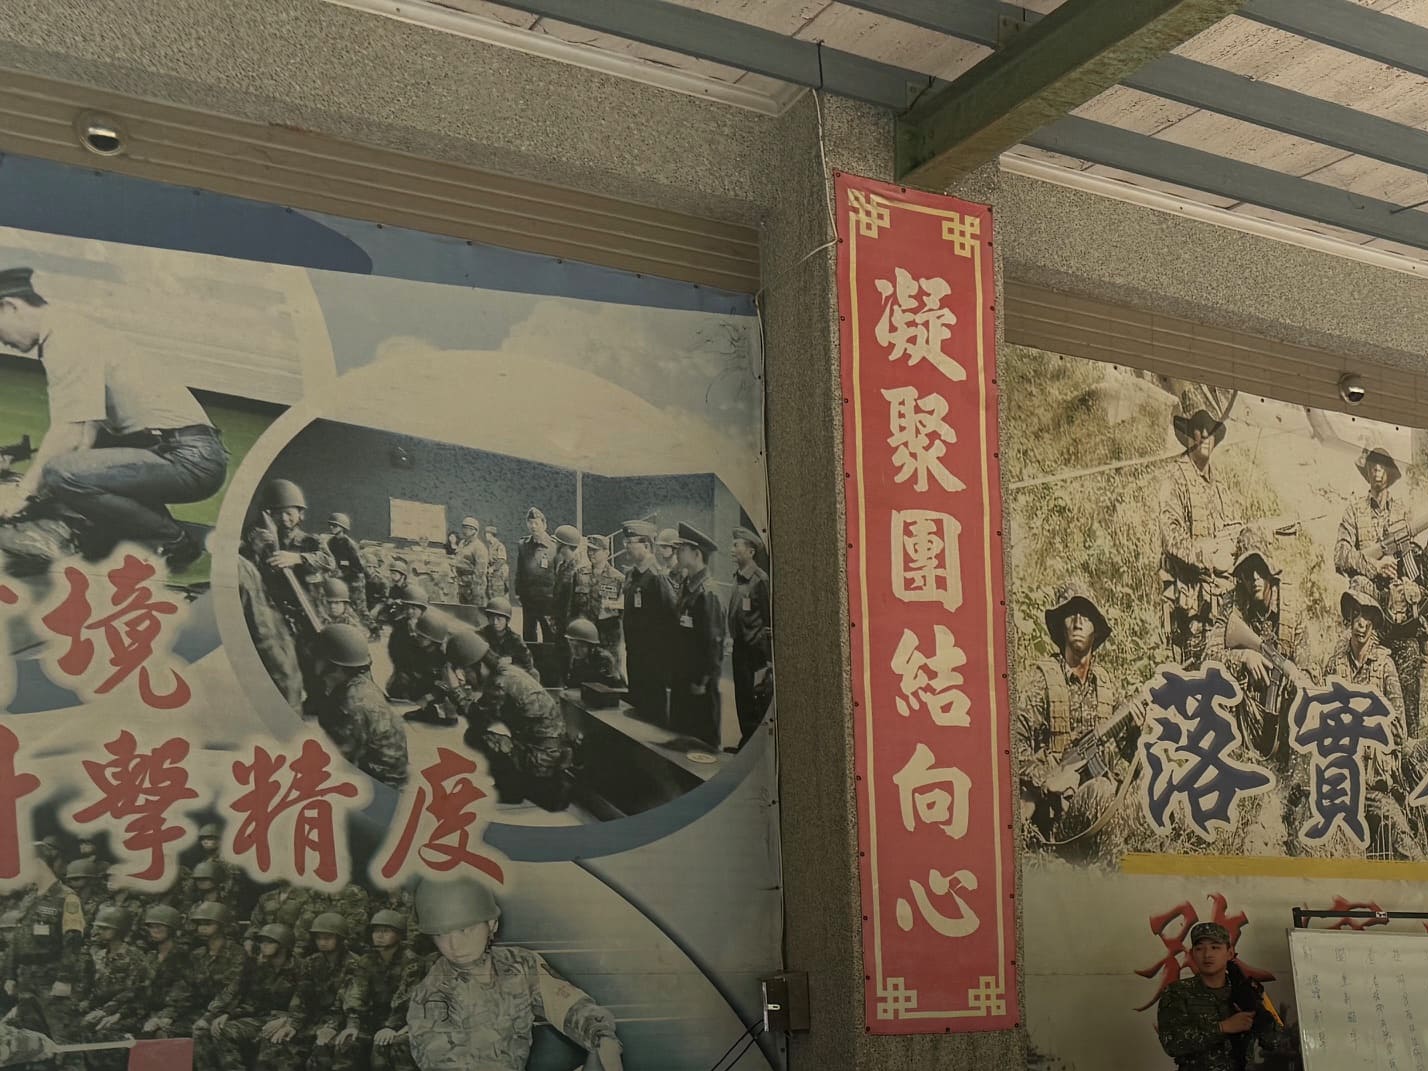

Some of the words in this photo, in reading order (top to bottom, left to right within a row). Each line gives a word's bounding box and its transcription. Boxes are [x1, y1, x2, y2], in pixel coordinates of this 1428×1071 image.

[0, 554, 191, 709] 境
[873, 265, 981, 939] 凝聚團結向心
